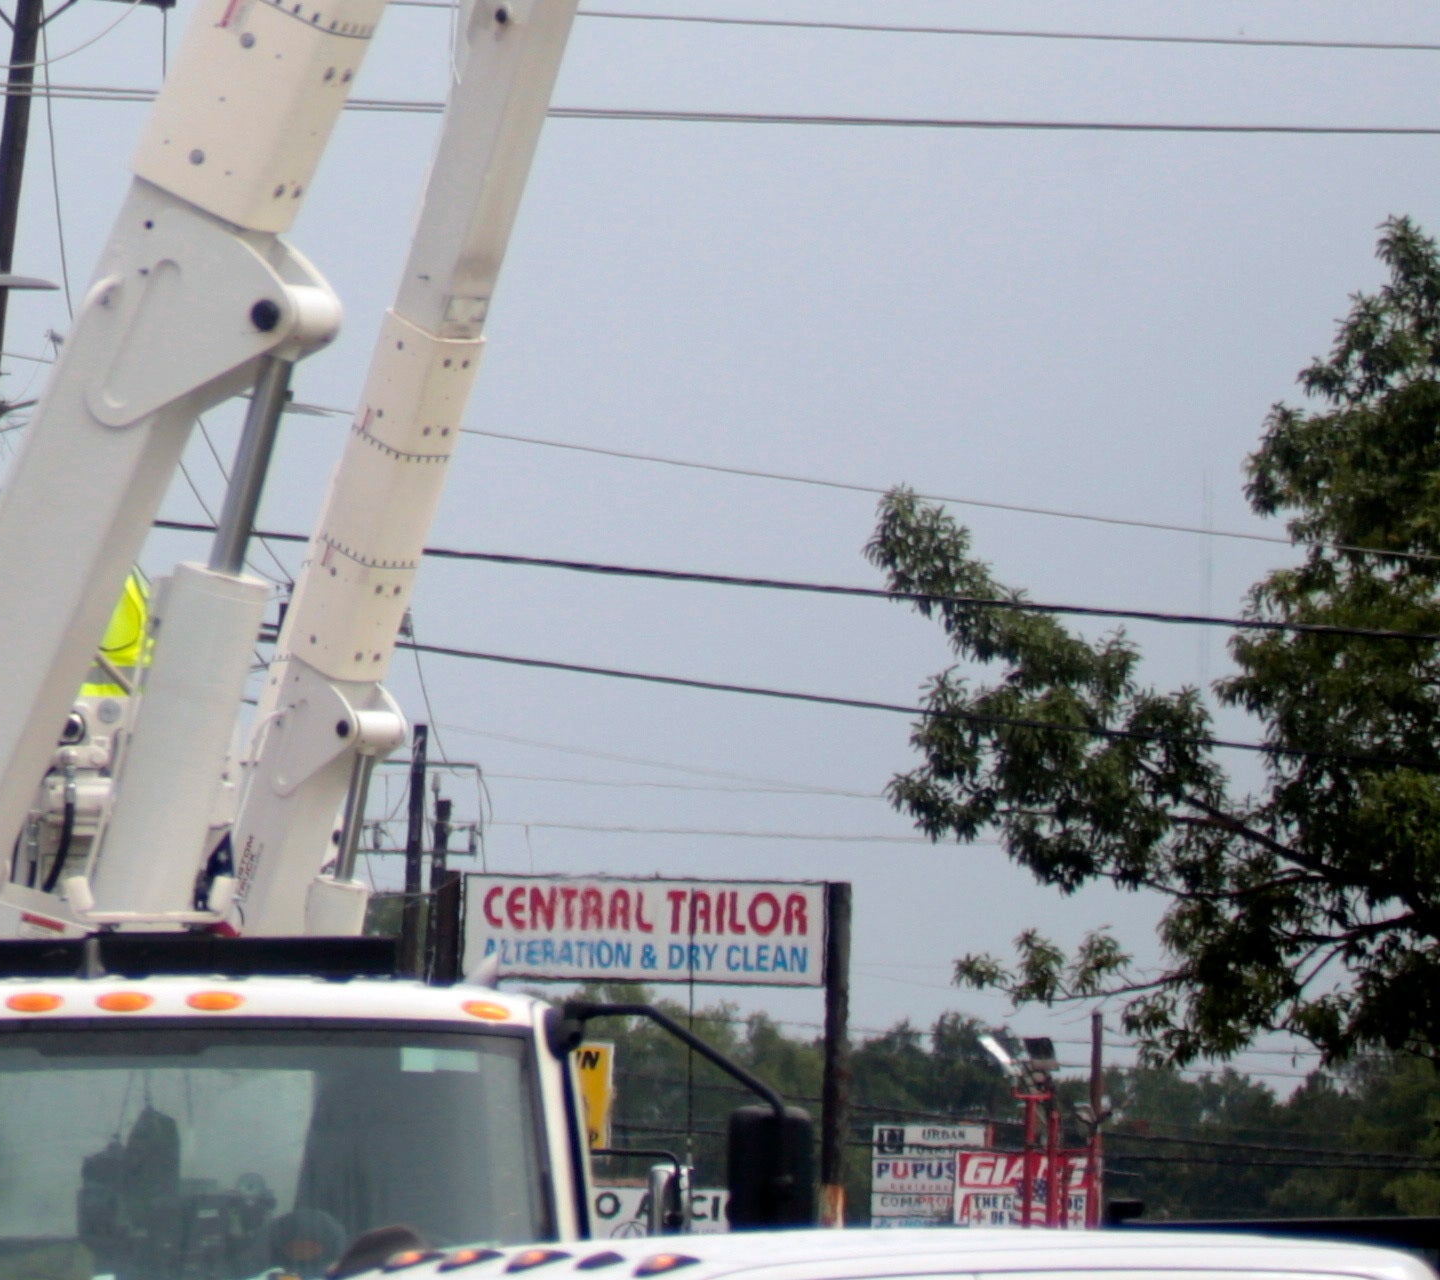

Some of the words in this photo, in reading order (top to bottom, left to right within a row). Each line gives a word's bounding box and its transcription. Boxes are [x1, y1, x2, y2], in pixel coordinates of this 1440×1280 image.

[483, 886, 654, 934] CENTRAL
[667, 890, 808, 936] TAILOR
[484, 938, 632, 969] ALTERATION
[640, 943, 658, 970] &
[668, 944, 717, 971] DRY
[725, 944, 808, 973] CLEAN
